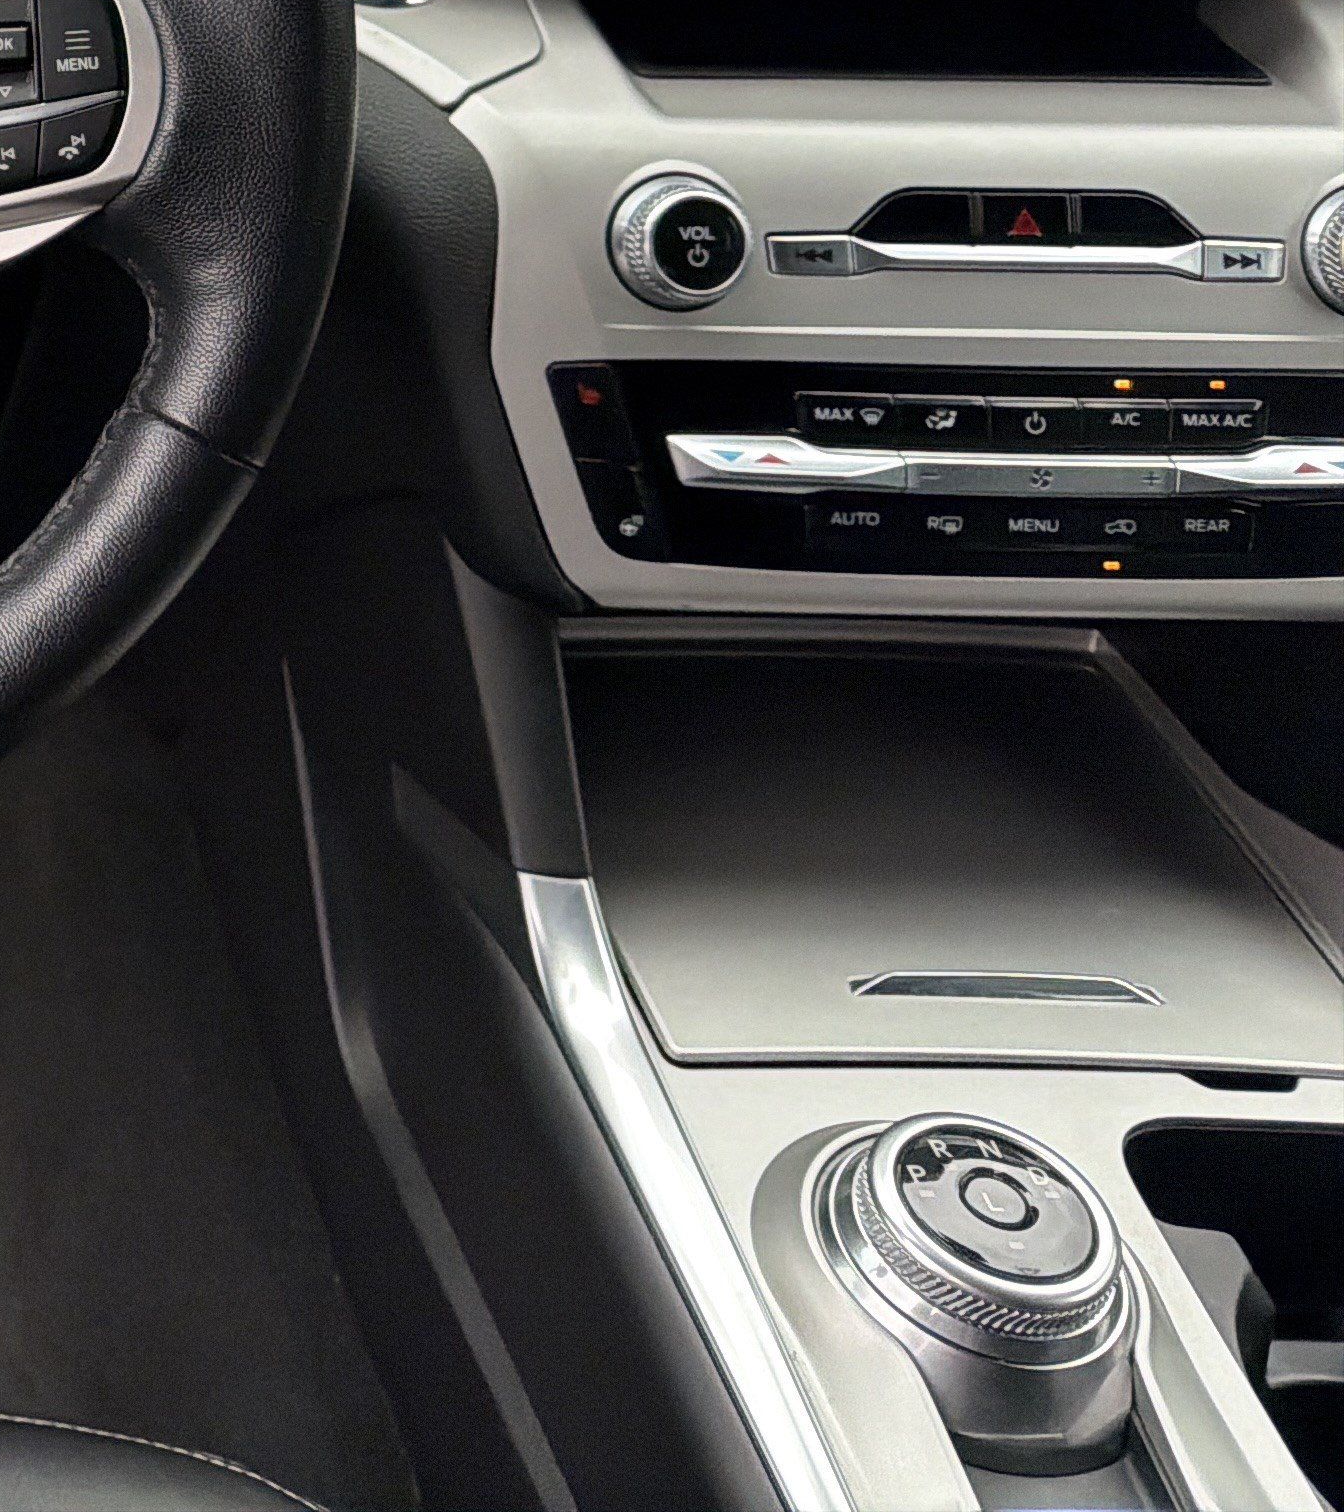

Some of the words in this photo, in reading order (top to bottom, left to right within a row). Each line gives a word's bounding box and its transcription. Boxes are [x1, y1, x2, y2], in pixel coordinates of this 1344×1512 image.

[56, 56, 99, 73] MENU
[677, 225, 716, 241] VOL
[814, 406, 854, 422] MAX
[1111, 412, 1141, 427] A/C
[1182, 413, 1221, 427] MAX
[1222, 412, 1253, 428] A/C
[830, 510, 880, 527] AUTO
[1008, 516, 1060, 533] MENU
[1184, 518, 1230, 533] REAR
[927, 1138, 954, 1159] R
[974, 1138, 1003, 1158] N
[906, 1164, 927, 1183] P
[1026, 1166, 1050, 1185] D
[981, 1192, 1005, 1213] L
